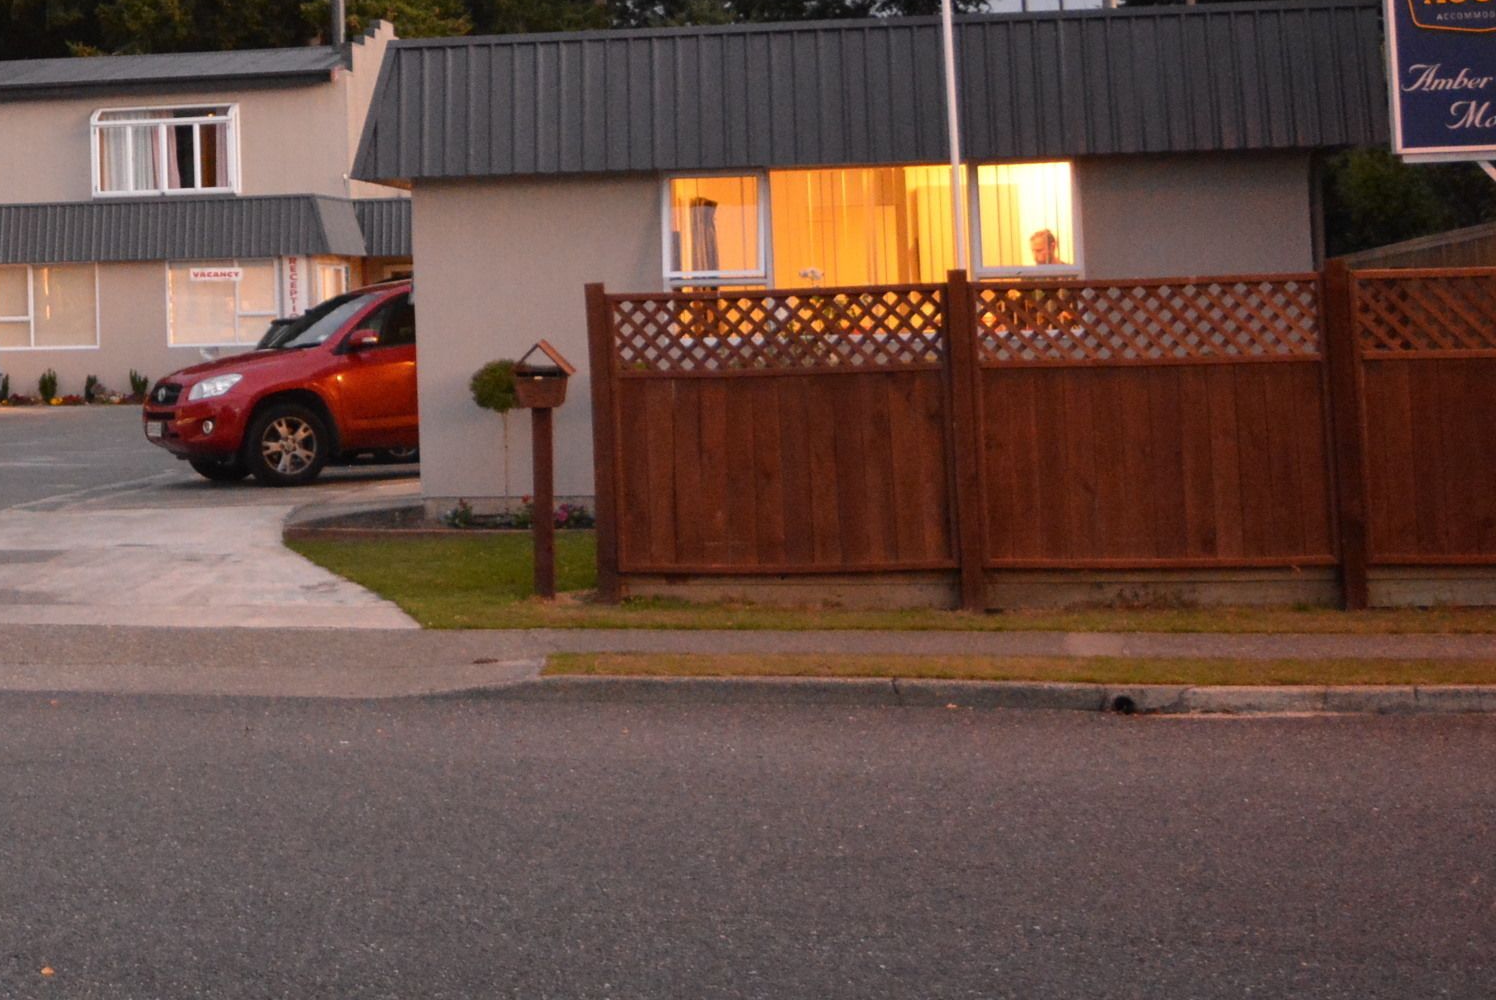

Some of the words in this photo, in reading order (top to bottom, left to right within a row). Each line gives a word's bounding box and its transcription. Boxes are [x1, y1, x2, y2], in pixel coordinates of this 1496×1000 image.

[1436, 10, 1496, 20] ACCOMMOD
[1401, 63, 1493, 91] Amber
[1445, 101, 1496, 129] Mo
[288, 257, 298, 318] RECEPTIO
